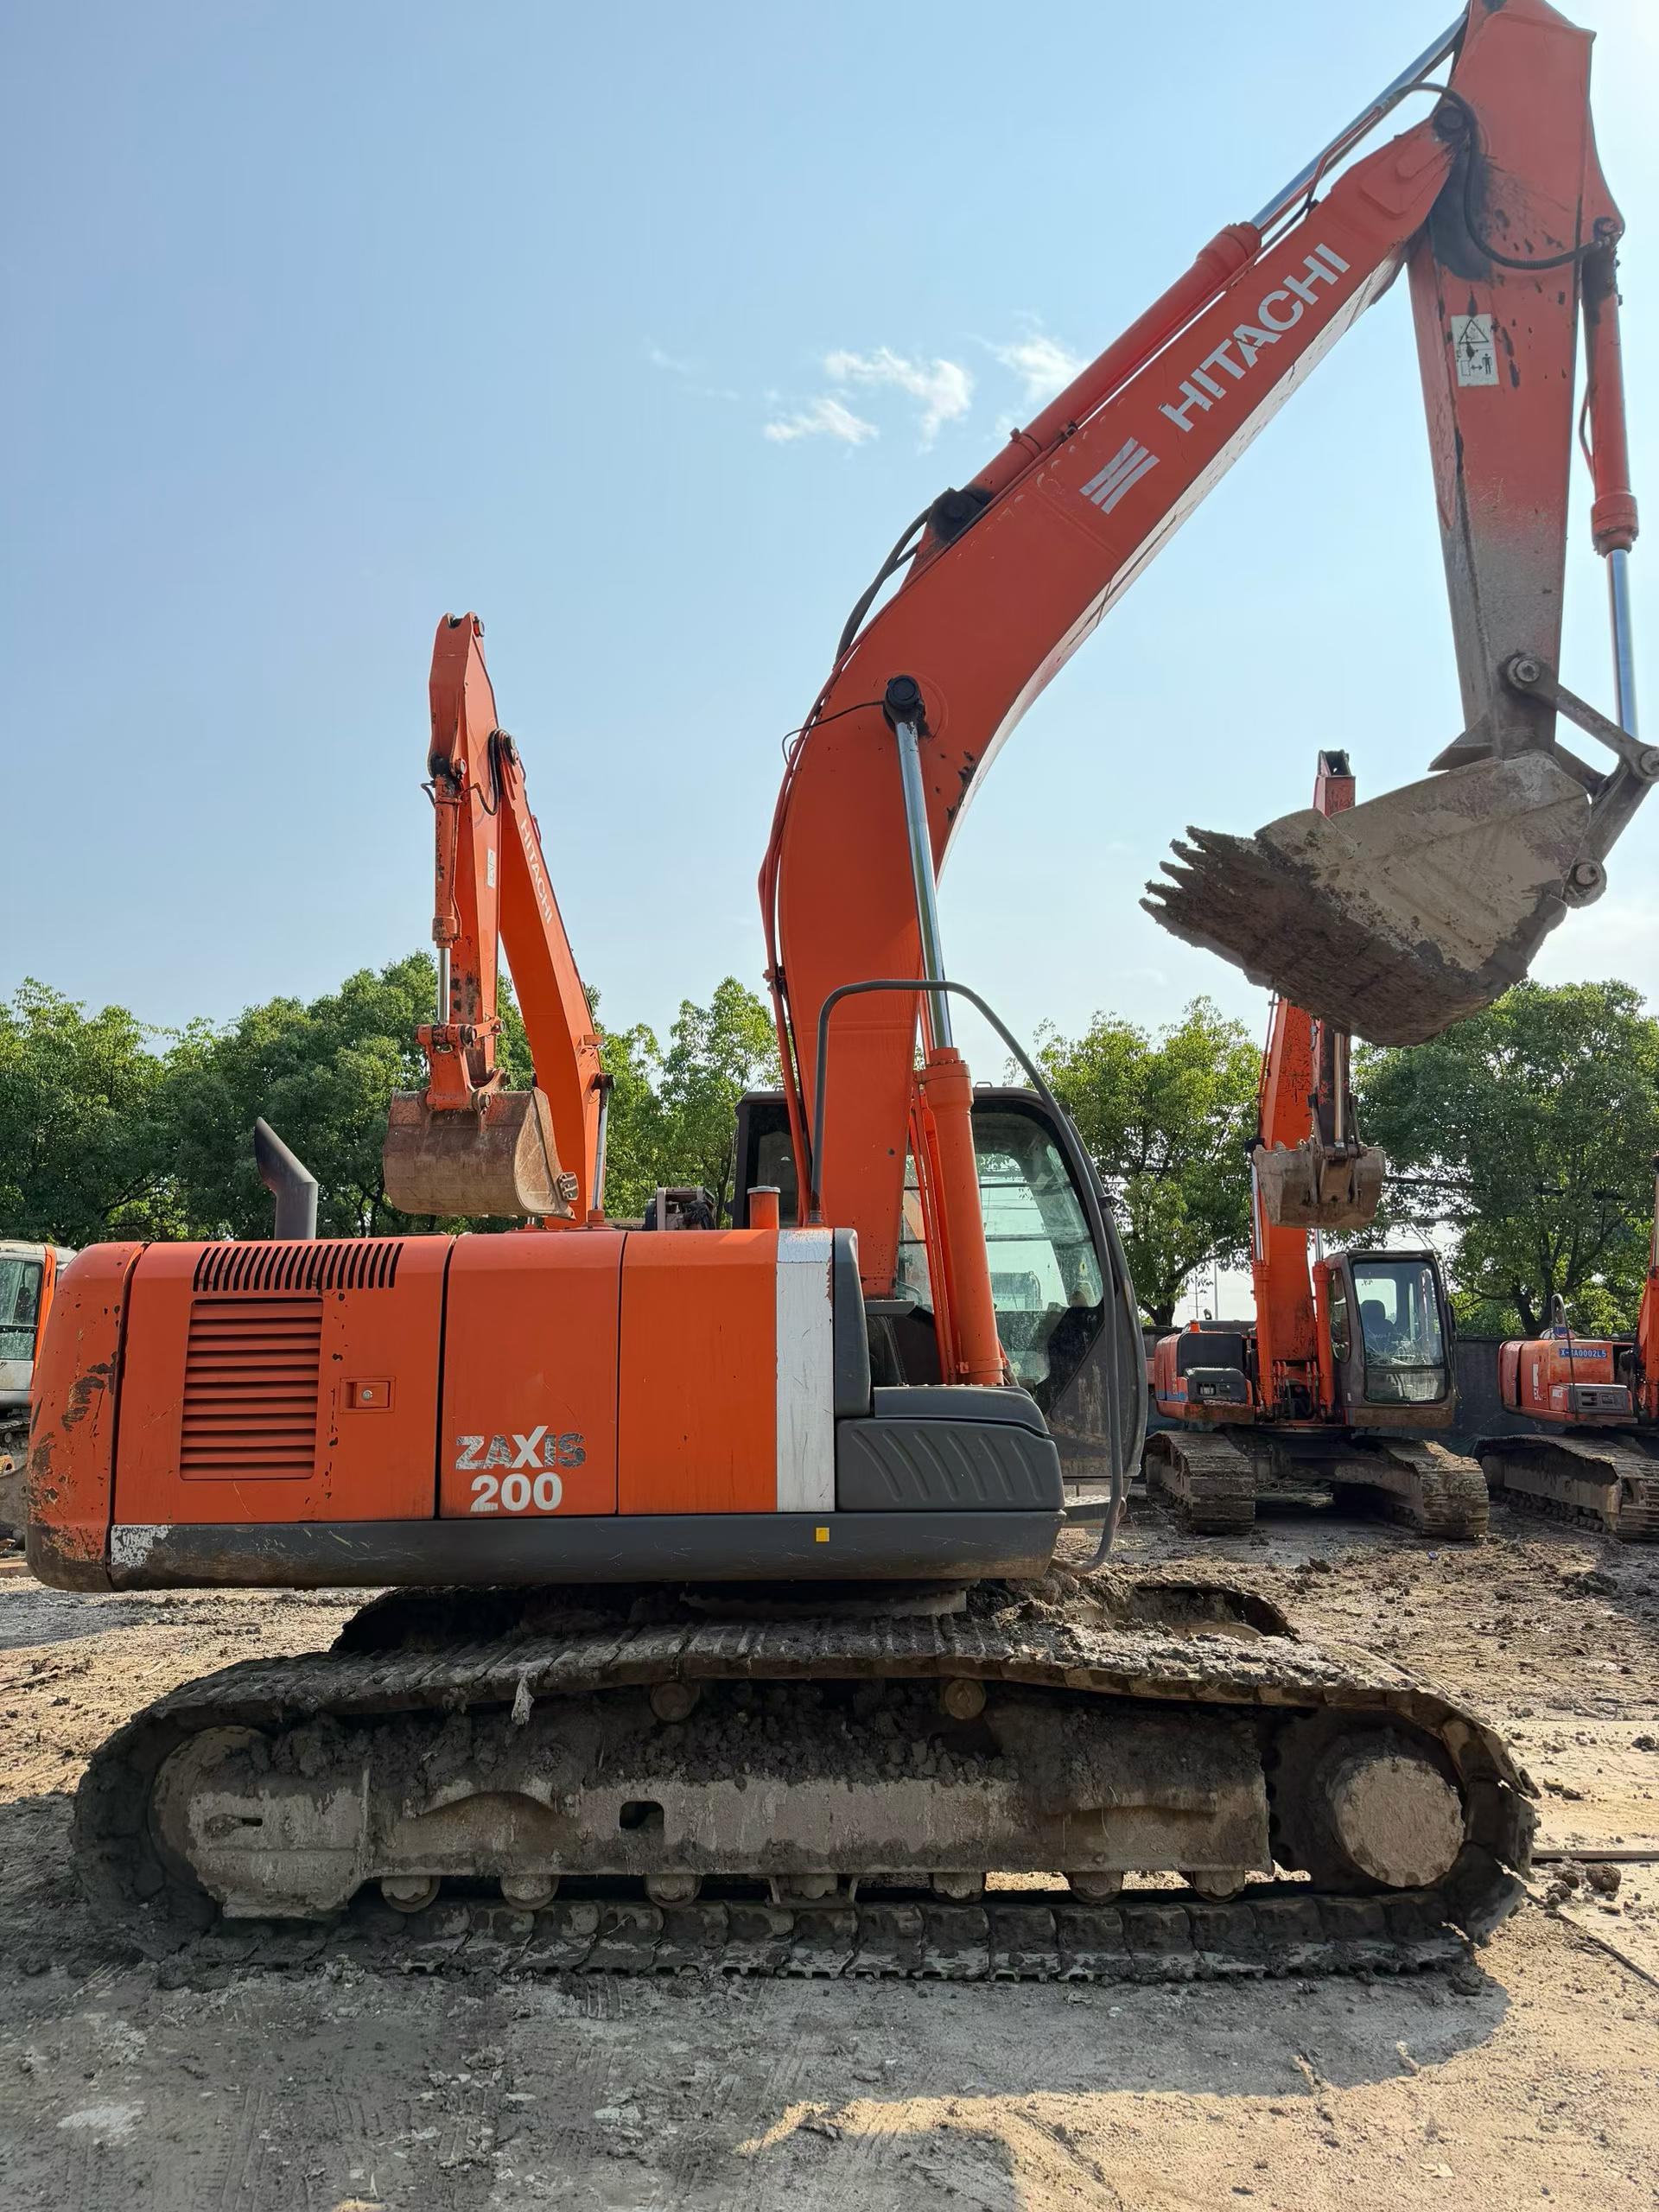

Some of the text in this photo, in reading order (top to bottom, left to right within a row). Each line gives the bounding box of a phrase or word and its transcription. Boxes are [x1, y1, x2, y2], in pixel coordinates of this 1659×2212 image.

[1158, 243, 1351, 432] HITACHI
[520, 818, 553, 925] HITACHI
[455, 1425, 588, 1470] ZAXIS
[469, 1471, 563, 1512] 200
